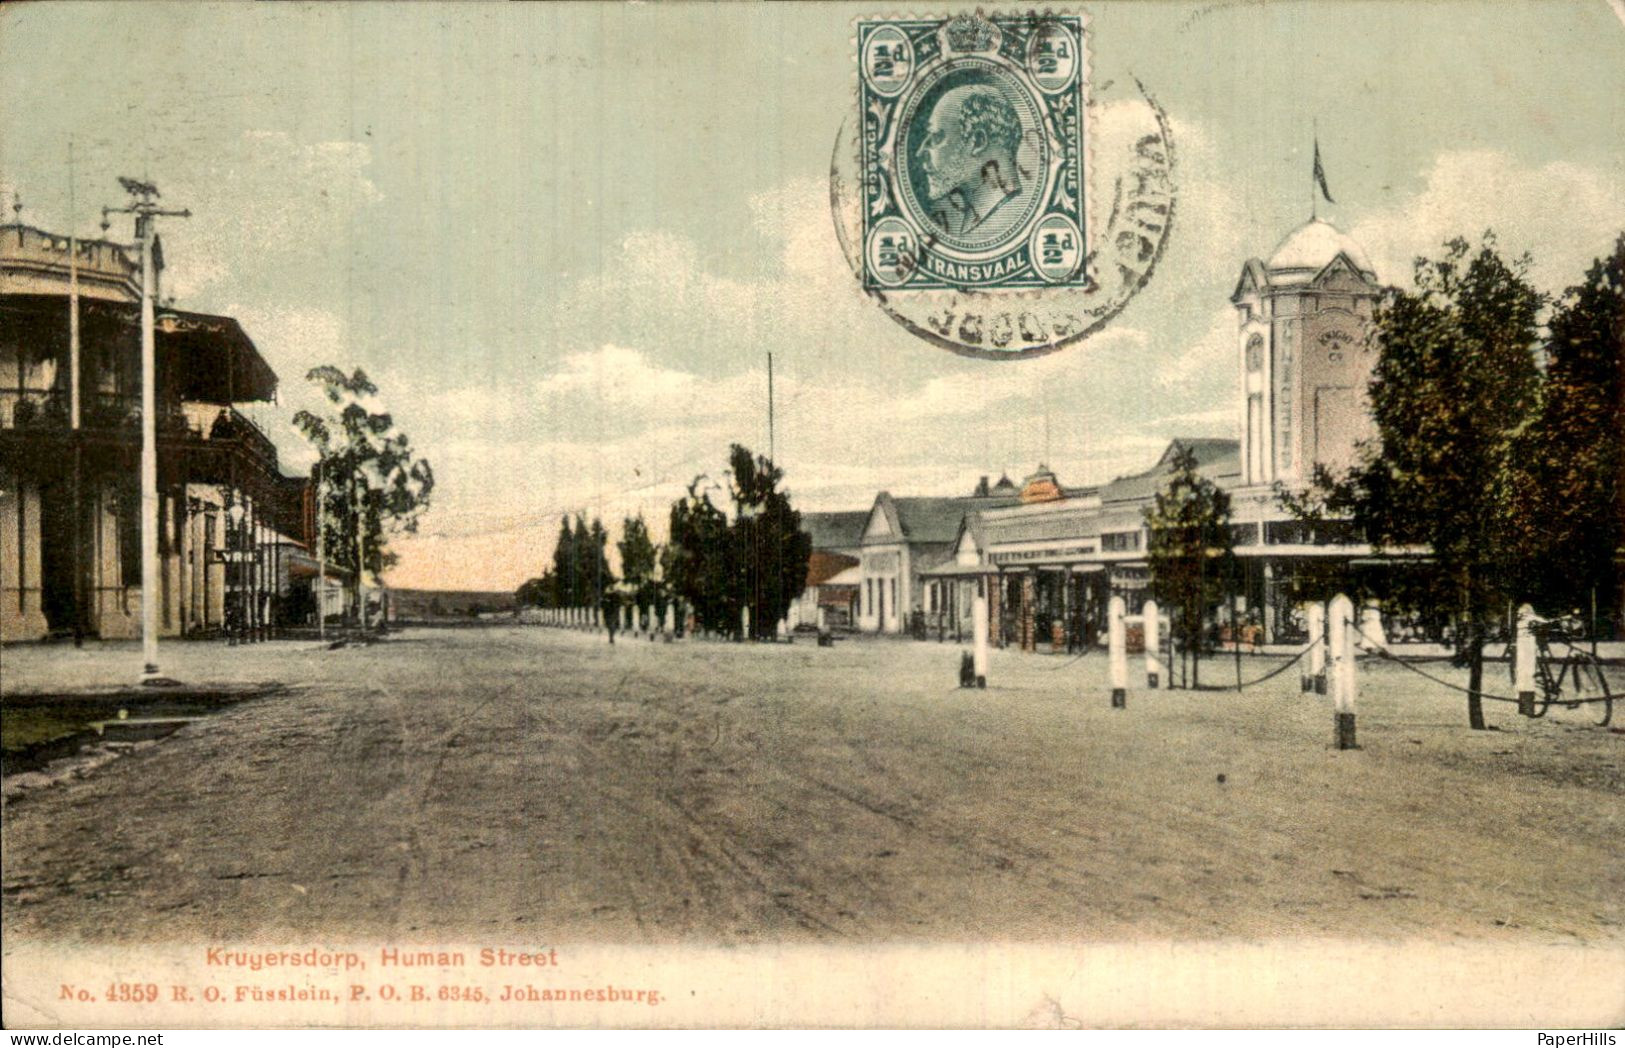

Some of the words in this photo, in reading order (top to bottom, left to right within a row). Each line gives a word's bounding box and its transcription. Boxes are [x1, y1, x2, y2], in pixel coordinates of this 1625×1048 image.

[866, 119, 878, 195] POSTAGE
[1066, 115, 1078, 191] REVENUE
[926, 252, 1027, 281] TRANSVAAL
